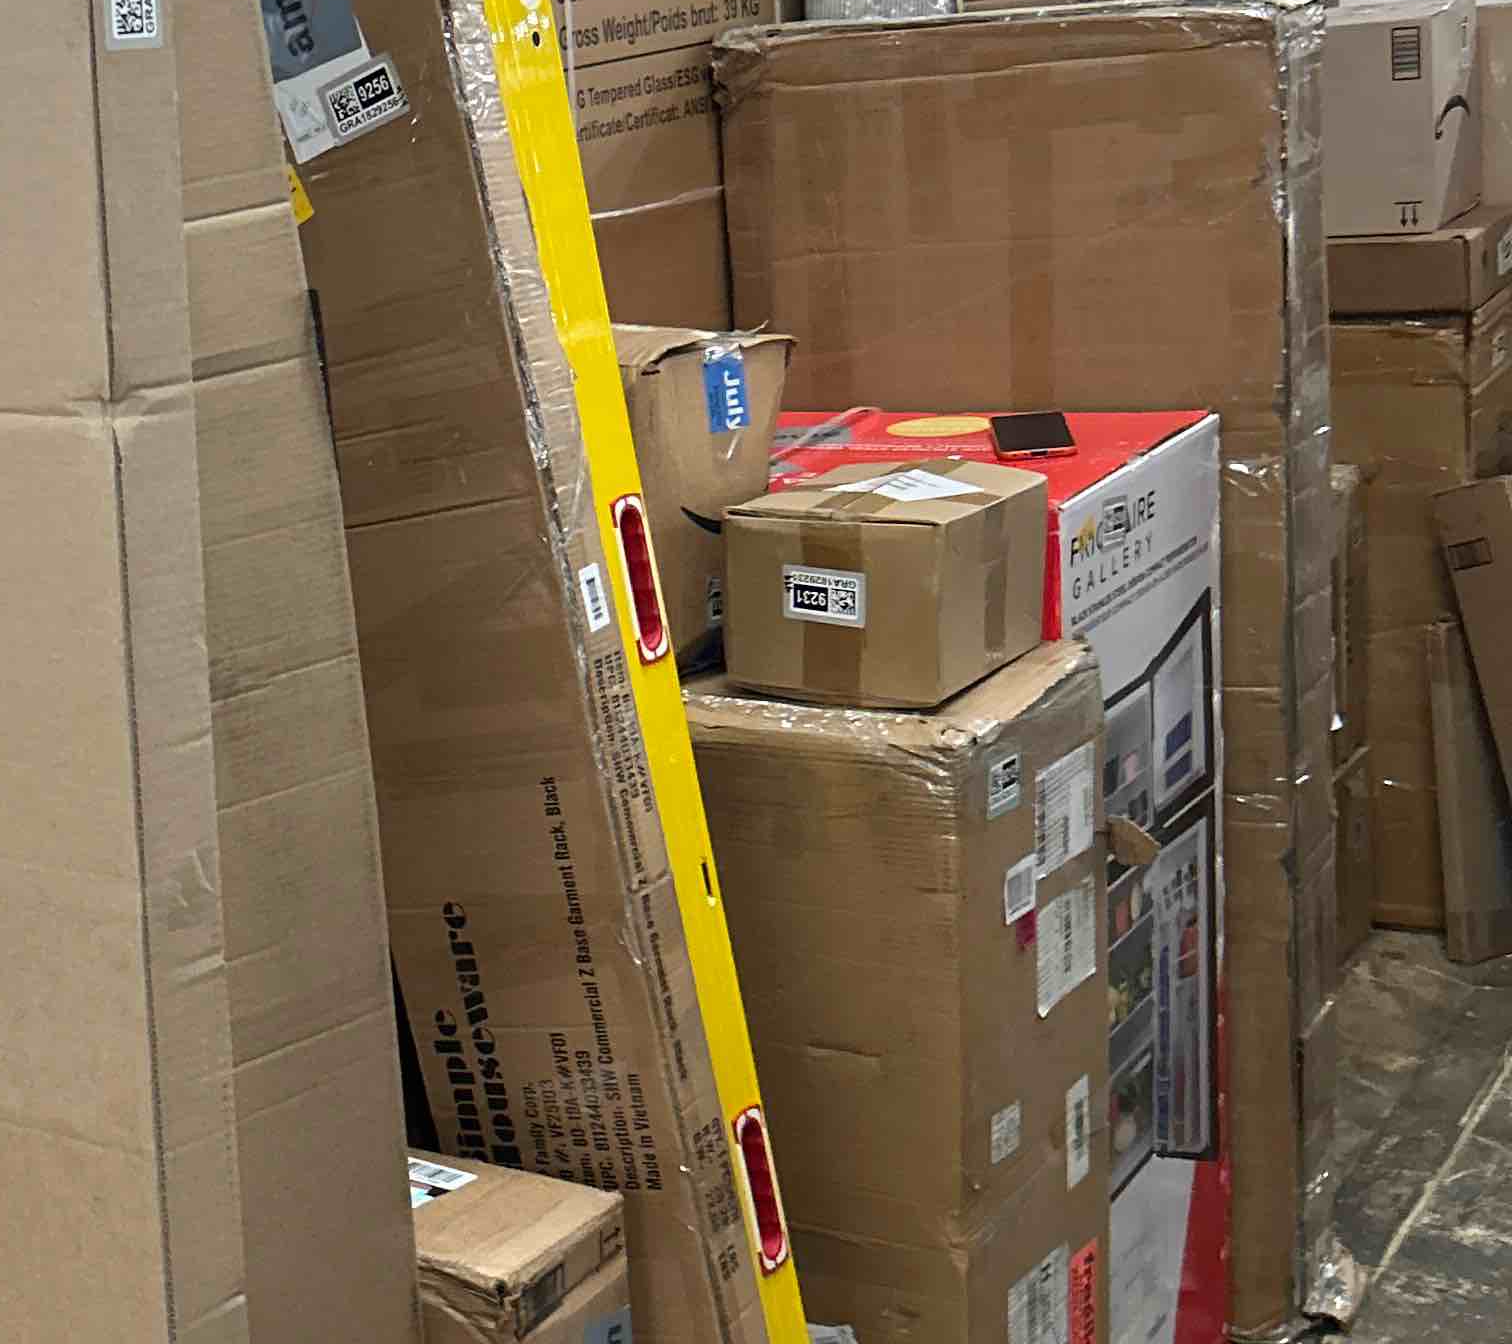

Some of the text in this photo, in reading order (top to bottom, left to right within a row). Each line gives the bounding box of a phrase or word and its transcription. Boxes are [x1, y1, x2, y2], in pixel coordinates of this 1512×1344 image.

[602, 8, 687, 46] Weight/Poids
[356, 71, 391, 105] 9256
[588, 80, 642, 107] Tempered
[576, 103, 681, 144] rtificate/Certificat:
[723, 370, 743, 430] July
[1071, 490, 1157, 568] FRIGIRE
[1072, 531, 1153, 600] GALLERY
[795, 587, 827, 608] 9231
[540, 776, 562, 817] Black
[550, 820, 570, 861] Rack,
[558, 865, 584, 927] Garment
[573, 928, 592, 964] Base
[578, 964, 594, 978] Z
[583, 982, 614, 1065] Commercial
[627, 1073, 652, 1133] Vietnam
[640, 1159, 663, 1191] Made
